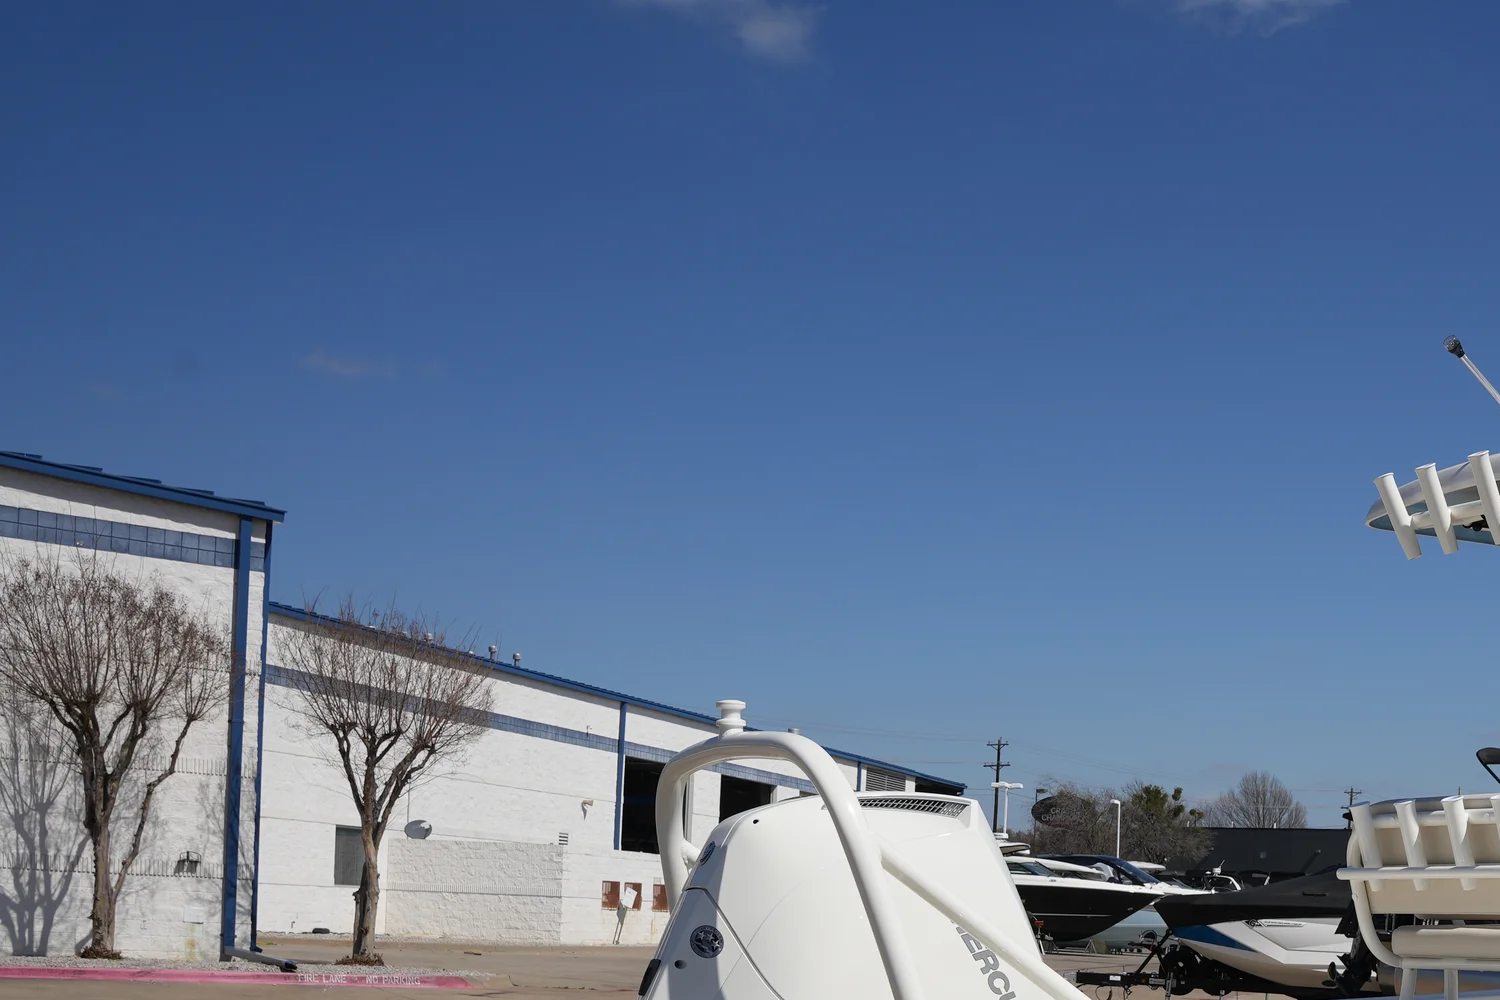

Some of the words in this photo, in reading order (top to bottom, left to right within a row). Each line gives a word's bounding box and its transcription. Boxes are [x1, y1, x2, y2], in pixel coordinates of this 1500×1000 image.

[297, 973, 319, 983] FIRE
[322, 974, 347, 984] LANE
[366, 975, 379, 984] NO
[382, 975, 421, 985] PARKING
